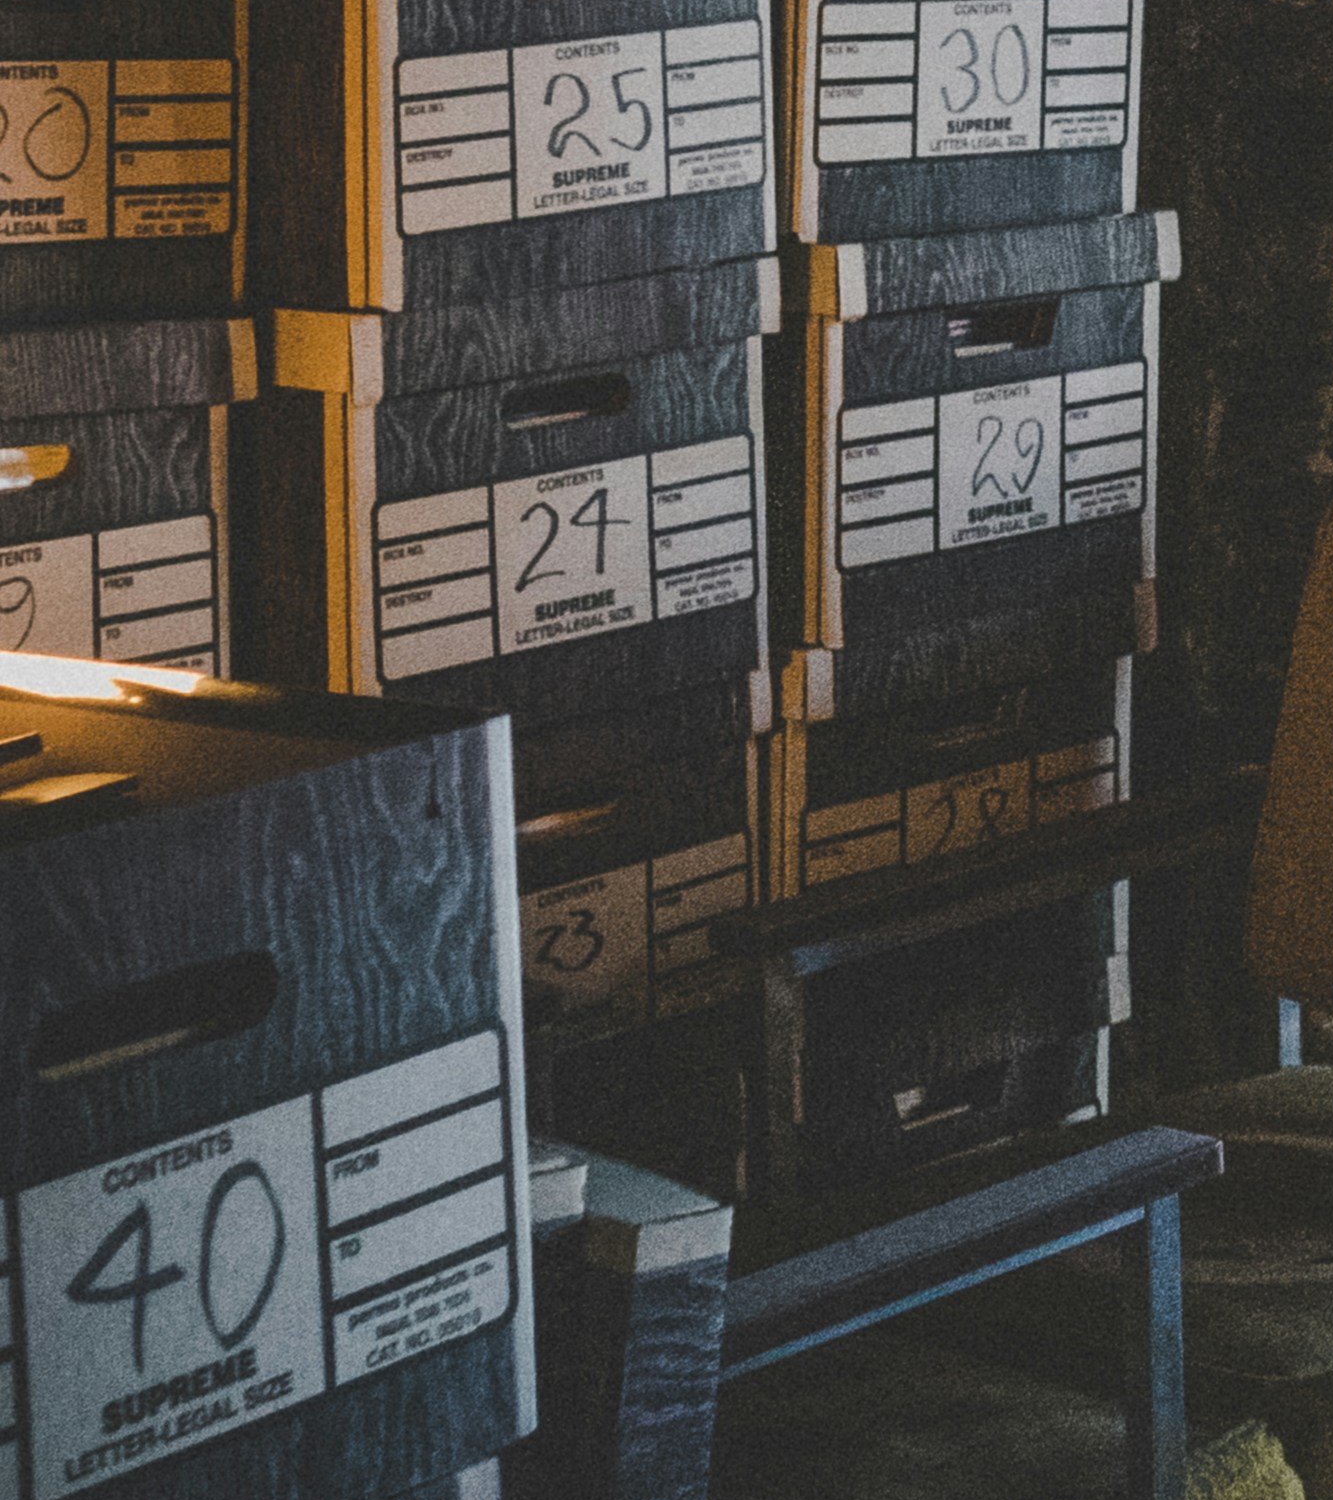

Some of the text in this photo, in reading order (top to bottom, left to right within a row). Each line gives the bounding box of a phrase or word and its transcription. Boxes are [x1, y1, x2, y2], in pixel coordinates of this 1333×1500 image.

[954, 3, 1012, 16] CONTENTS
[555, 41, 621, 60] CONTENTS
[940, 23, 1030, 114] 30
[543, 66, 652, 158] 25
[946, 117, 1013, 135] SUPREME
[551, 162, 631, 189] SUPREME
[623, 180, 648, 195] SIZE
[972, 385, 1031, 405] CONTENTS
[971, 415, 1044, 500] 29
[536, 468, 605, 493] CONTENTS
[967, 496, 1034, 524] SUPREME
[514, 487, 631, 594] 24
[534, 588, 616, 622] SUPREME
[534, 910, 604, 972] 23
[102, 1129, 233, 1194] CONTENTS
[332, 1149, 380, 1181] FROM
[337, 1237, 362, 1260] TO
[65, 1157, 286, 1374] 40
[101, 1347, 257, 1434] SUPREME
[244, 1370, 294, 1410] SIZE
